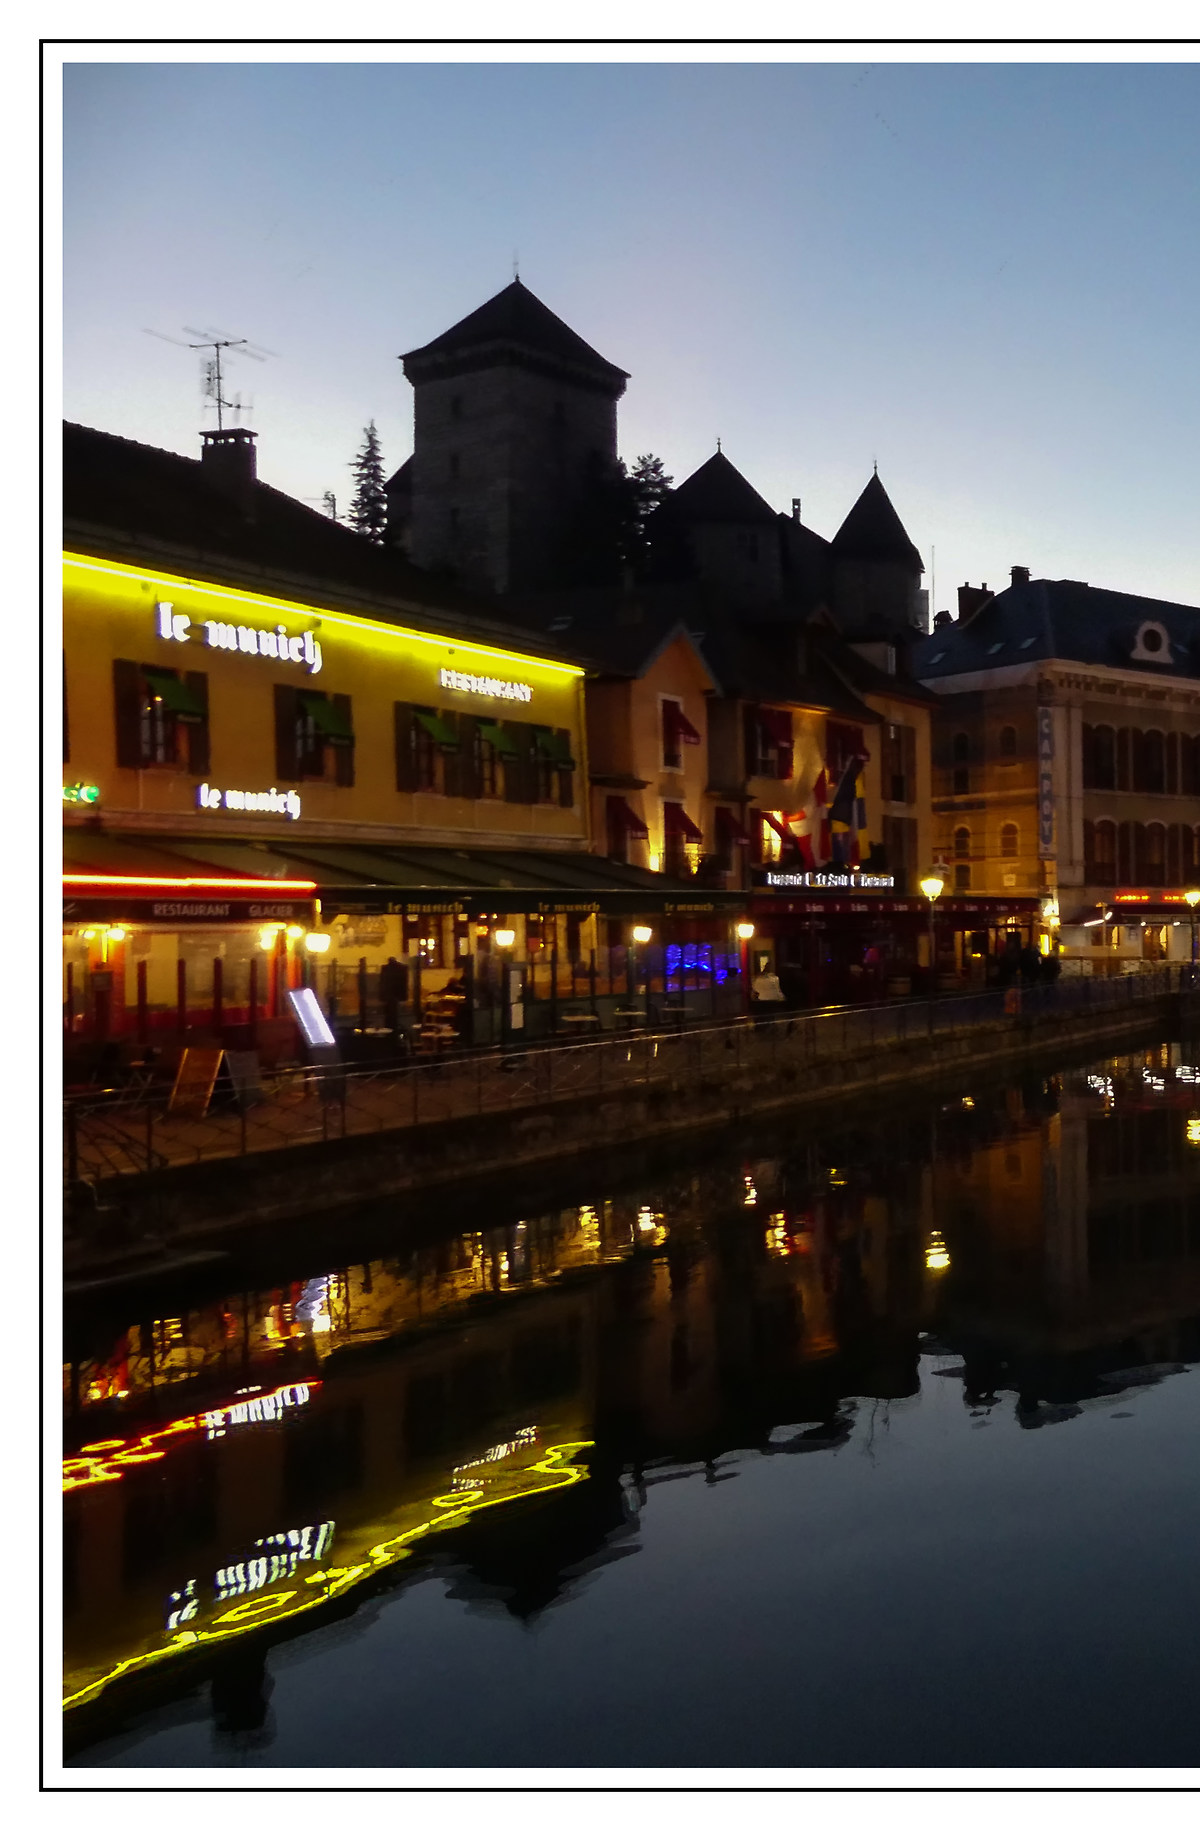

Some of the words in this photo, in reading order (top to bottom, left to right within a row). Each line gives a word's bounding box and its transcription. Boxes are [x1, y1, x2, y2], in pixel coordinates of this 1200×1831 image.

[158, 602, 192, 642] le
[204, 614, 323, 674] munich
[199, 783, 222, 809] le
[224, 787, 301, 820] munich
[153, 903, 231, 917] RESTAURANT
[249, 904, 294, 918] GLACIER
[406, 902, 464, 914] munich
